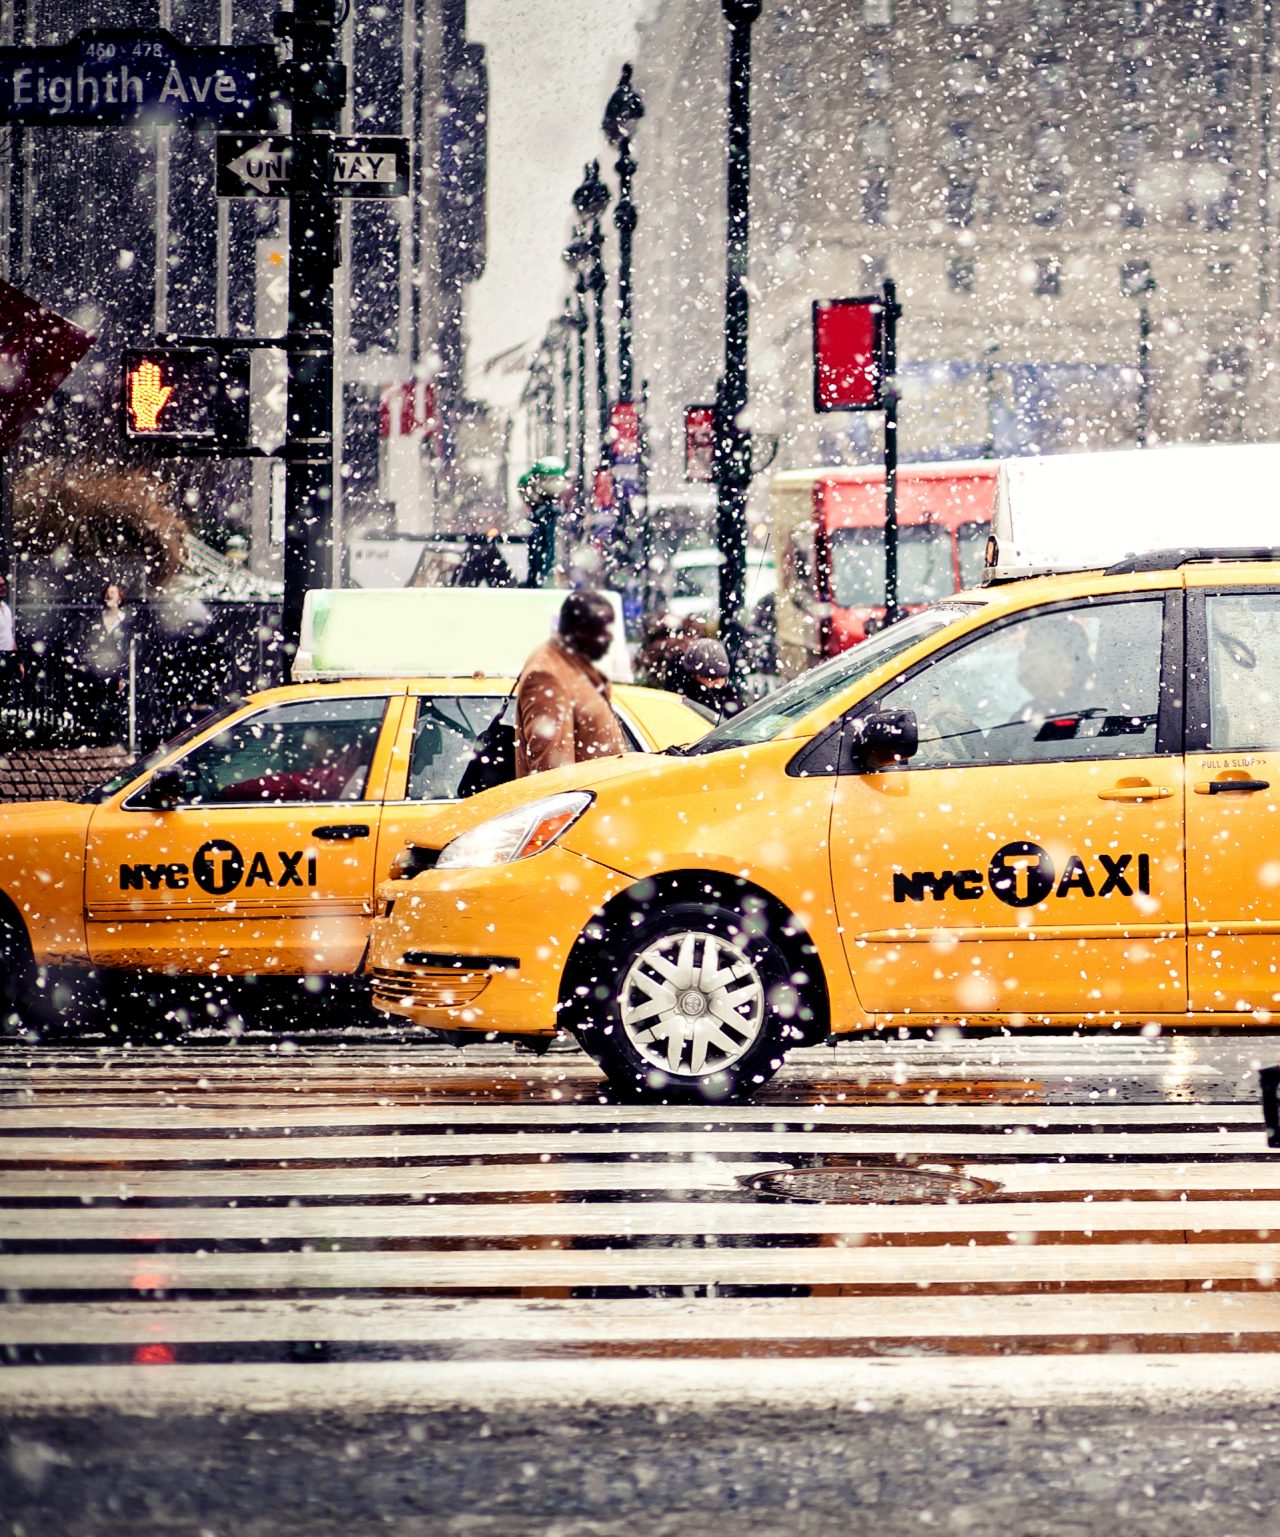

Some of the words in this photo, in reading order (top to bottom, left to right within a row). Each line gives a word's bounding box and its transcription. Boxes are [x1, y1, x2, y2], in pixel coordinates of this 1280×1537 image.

[85, 43, 116, 57] 460
[132, 43, 163, 57] 478
[13, 65, 144, 114] Eighth
[158, 66, 238, 103] Ave
[1201, 760, 1221, 769] PULL
[1223, 759, 1230, 768] &
[119, 863, 189, 890] NYC
[193, 839, 317, 896] TAXI
[893, 869, 983, 902] NYC
[988, 841, 1150, 907] TAXI
